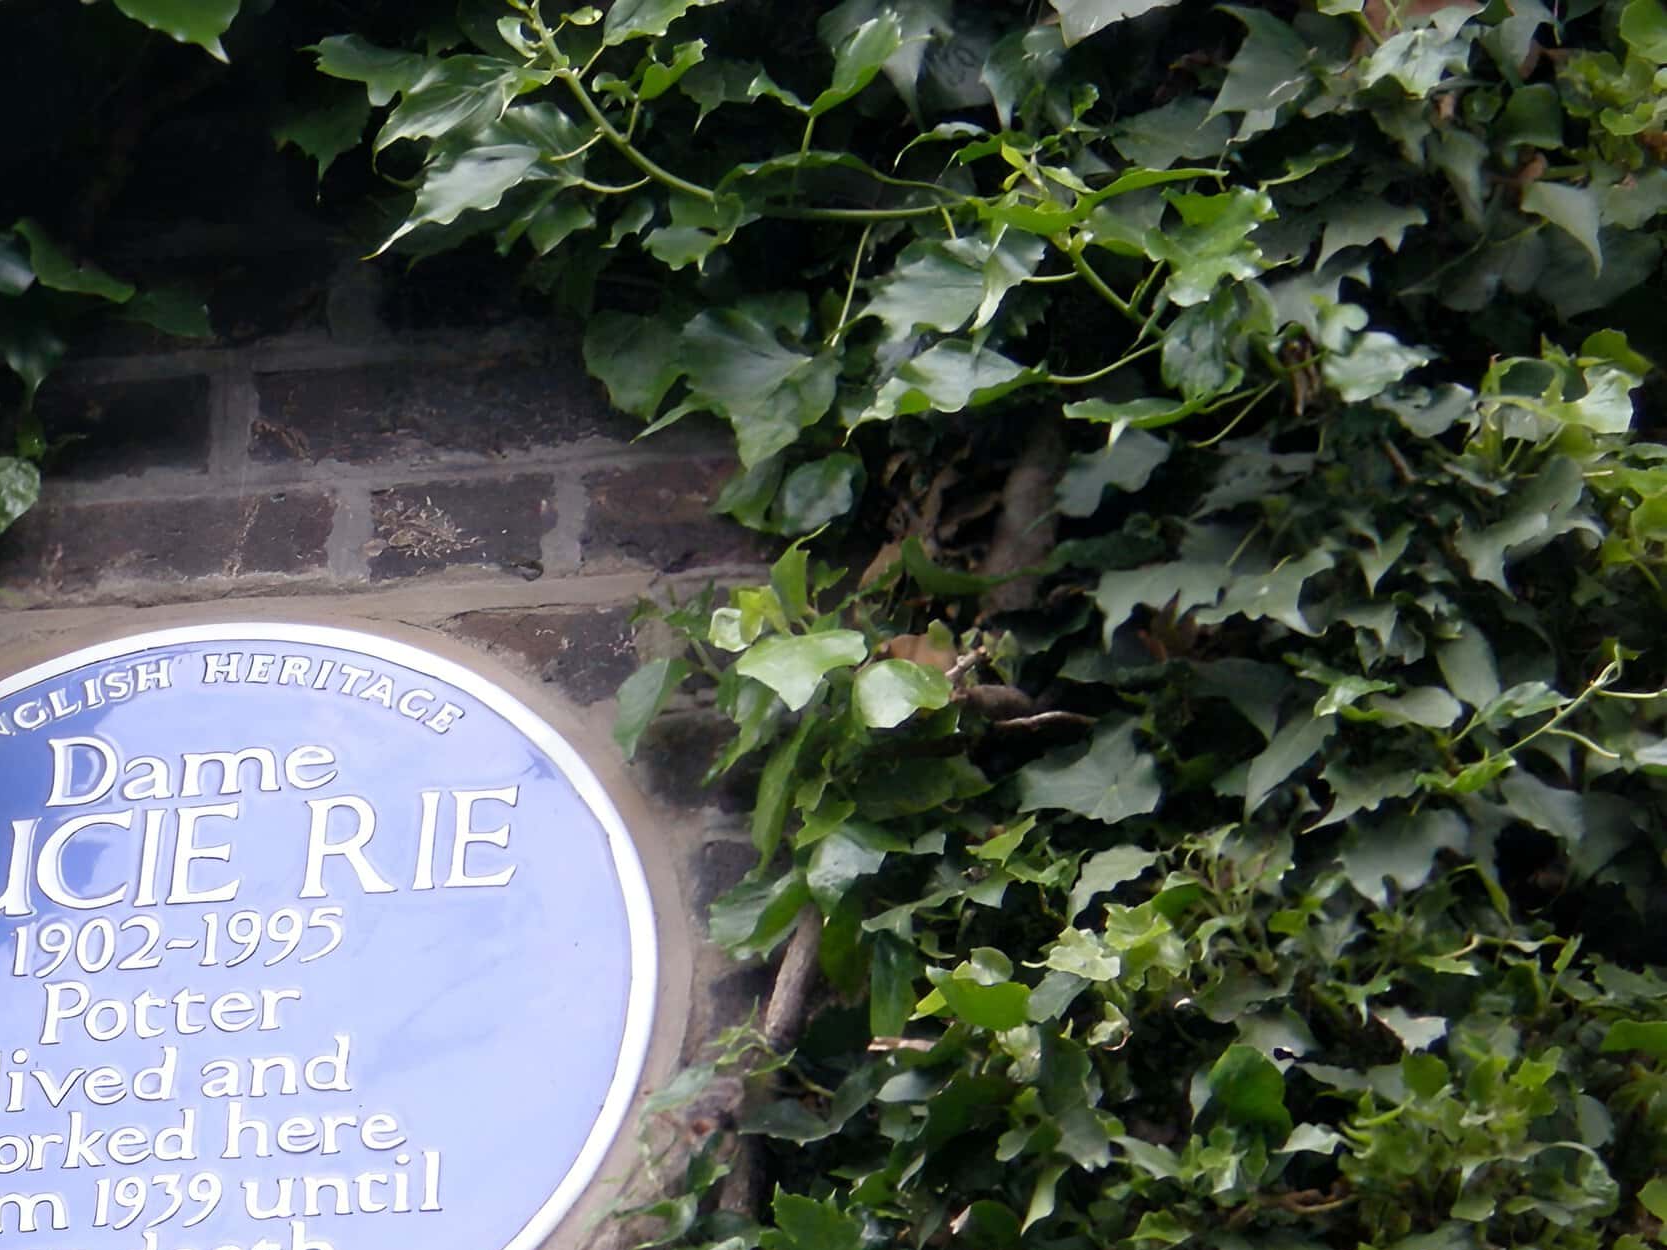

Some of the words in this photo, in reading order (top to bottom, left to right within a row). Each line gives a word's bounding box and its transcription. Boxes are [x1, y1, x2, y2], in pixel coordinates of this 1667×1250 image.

[203, 652, 466, 734] HERITAGE
[46, 737, 337, 807] Dame
[299, 786, 520, 898] RIE
[40, 981, 301, 1045] Potter
[201, 1035, 353, 1098] and
[220, 1102, 407, 1159] here
[93, 1171, 223, 1230] 1939
[243, 1151, 443, 1219] until
